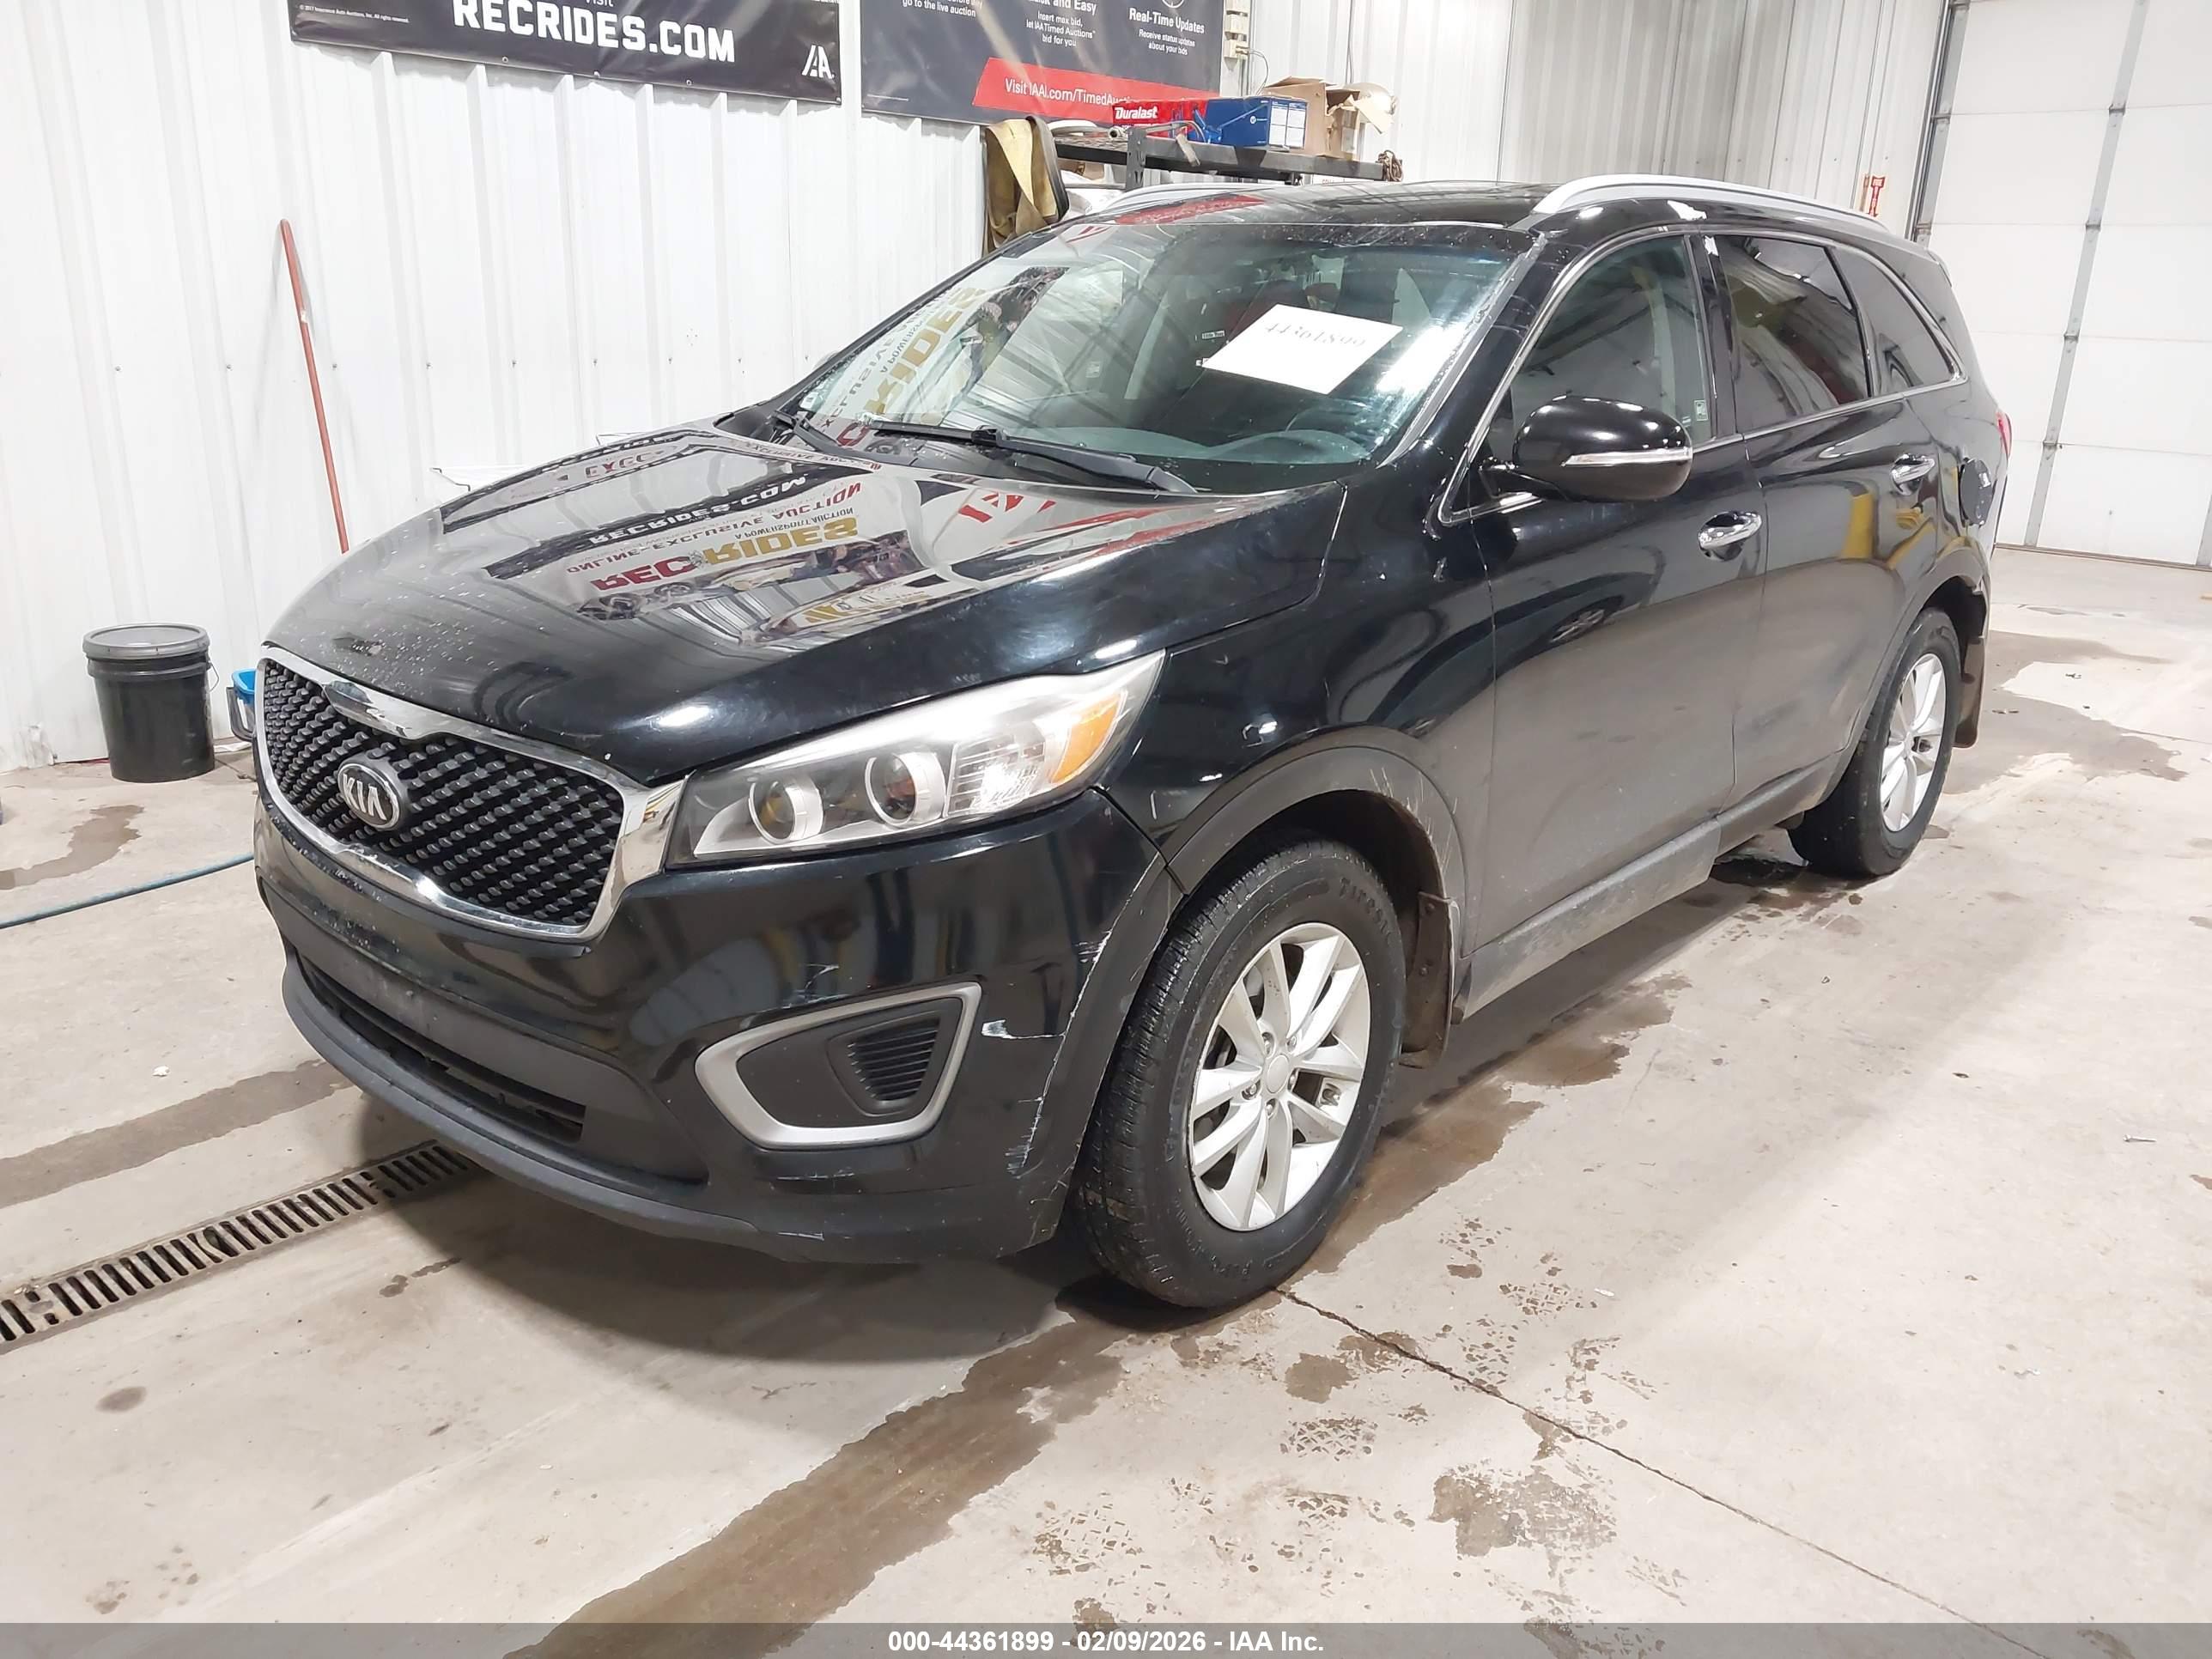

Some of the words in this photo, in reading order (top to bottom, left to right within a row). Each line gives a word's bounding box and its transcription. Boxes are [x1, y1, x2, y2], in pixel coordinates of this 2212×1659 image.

[924, 1, 936, 9] the
[937, 2, 949, 12] live
[950, 6, 976, 17] auction
[1074, 0, 1097, 15] Easy
[1037, 10, 1054, 22] Insert
[1071, 17, 1083, 27] bid,
[1129, 7, 1175, 27] Real-Time
[1176, 16, 1205, 33] Updates
[453, 0, 736, 63] RECRIDES.COM
[1042, 33, 1052, 43] bid
[1054, 35, 1063, 45] for
[1139, 28, 1161, 40] Receive
[1162, 33, 1178, 43] status
[1149, 41, 1164, 51] about
[1165, 45, 1177, 53] your
[1178, 46, 1188, 55] bids
[1005, 78, 1027, 94] Visit
[1115, 106, 1158, 119] Duralast
[343, 773, 386, 821] KIA
